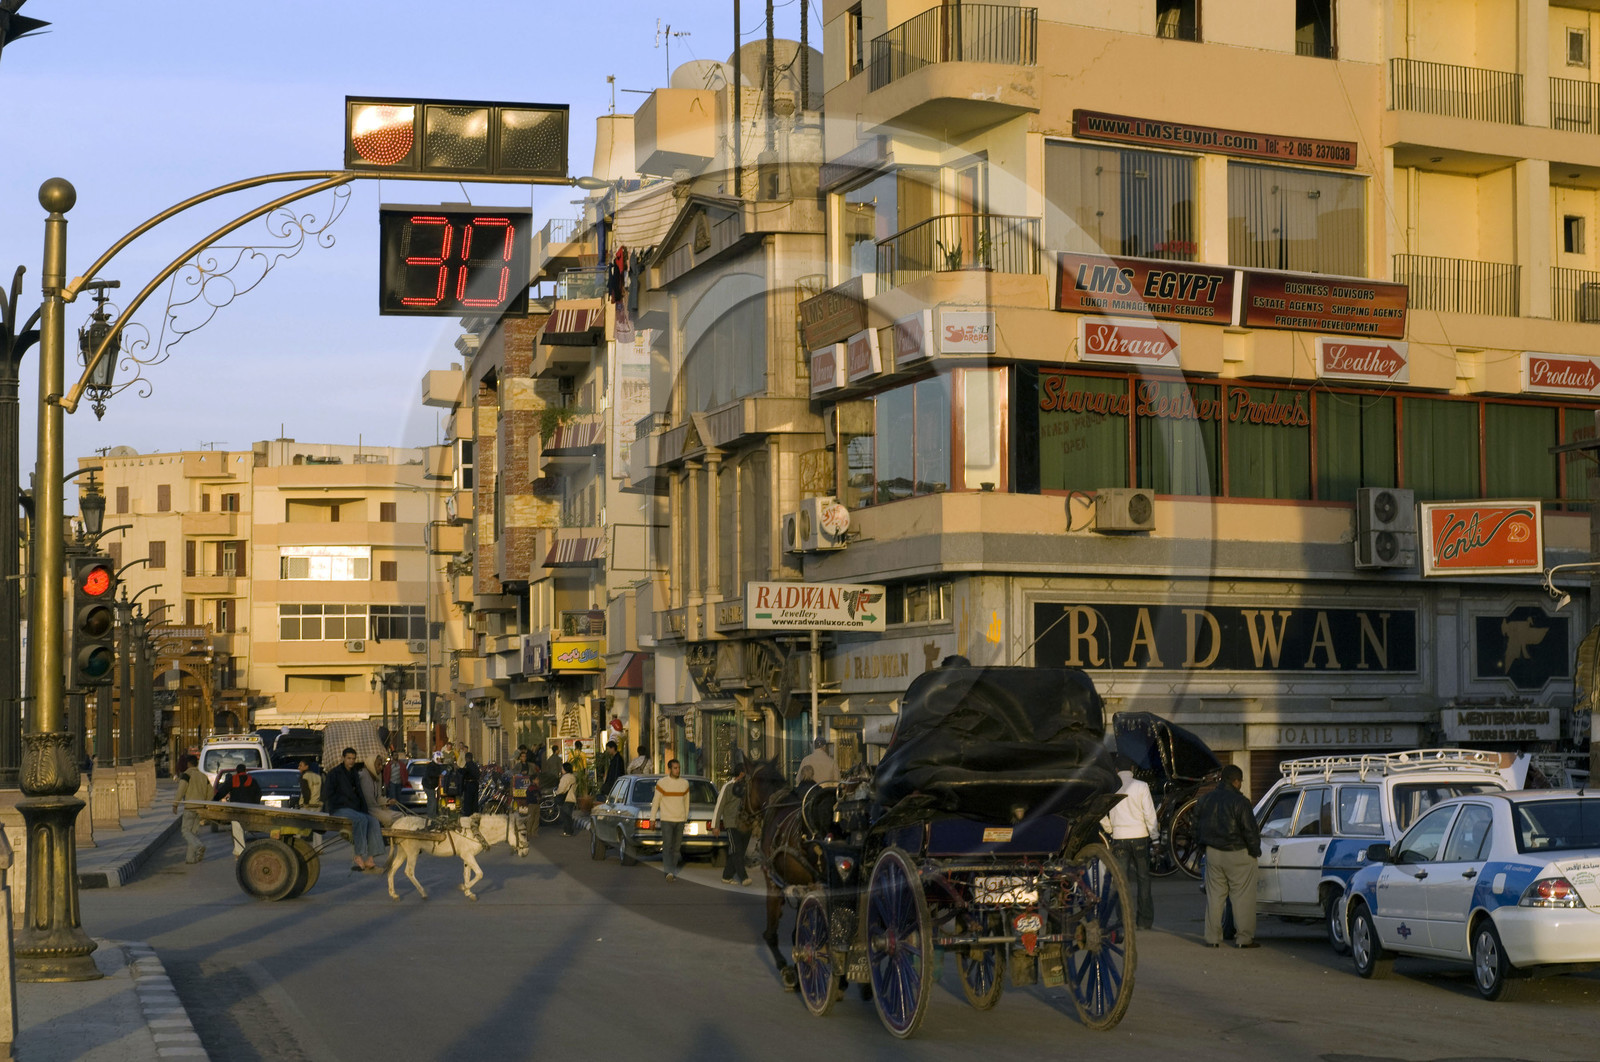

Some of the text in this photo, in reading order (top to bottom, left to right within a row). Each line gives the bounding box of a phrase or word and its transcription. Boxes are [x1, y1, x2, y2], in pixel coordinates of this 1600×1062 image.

[1087, 117, 1351, 161] www.LMSEgypt.com Tel: +2 095 2370038
[1169, 239, 1197, 256] OPEN
[401, 216, 515, 307] 30
[1074, 264, 1224, 303] LMS EGYPT
[1285, 282, 1375, 300] BUSINESS ADVISORS
[1080, 296, 1215, 317] LUXOR MANAGEMENT SERVICES
[1253, 296, 1403, 319] ESTATE AGENTS SHIPPING AGENTS
[1275, 316, 1379, 332] PROPERTY DEVELOPMENT
[1087, 325, 1168, 356] Shrara
[1326, 345, 1398, 373] Leather
[1531, 360, 1595, 386] Products
[1040, 376, 1310, 427] Sharara Leather Products
[1435, 509, 1534, 566] Venti
[1507, 522, 1530, 543] 20
[756, 586, 842, 610] RADWAN
[772, 618, 864, 627] www.radwanluxor.com
[780, 610, 818, 619] Jewellery
[1064, 604, 1391, 669] RADWAN
[854, 653, 909, 680] RADWAN
[1457, 711, 1549, 726] MEDITERRANEAN
[1277, 727, 1393, 744] JOAILLERIE
[1468, 729, 1539, 740] TOURS & TRAVEL
